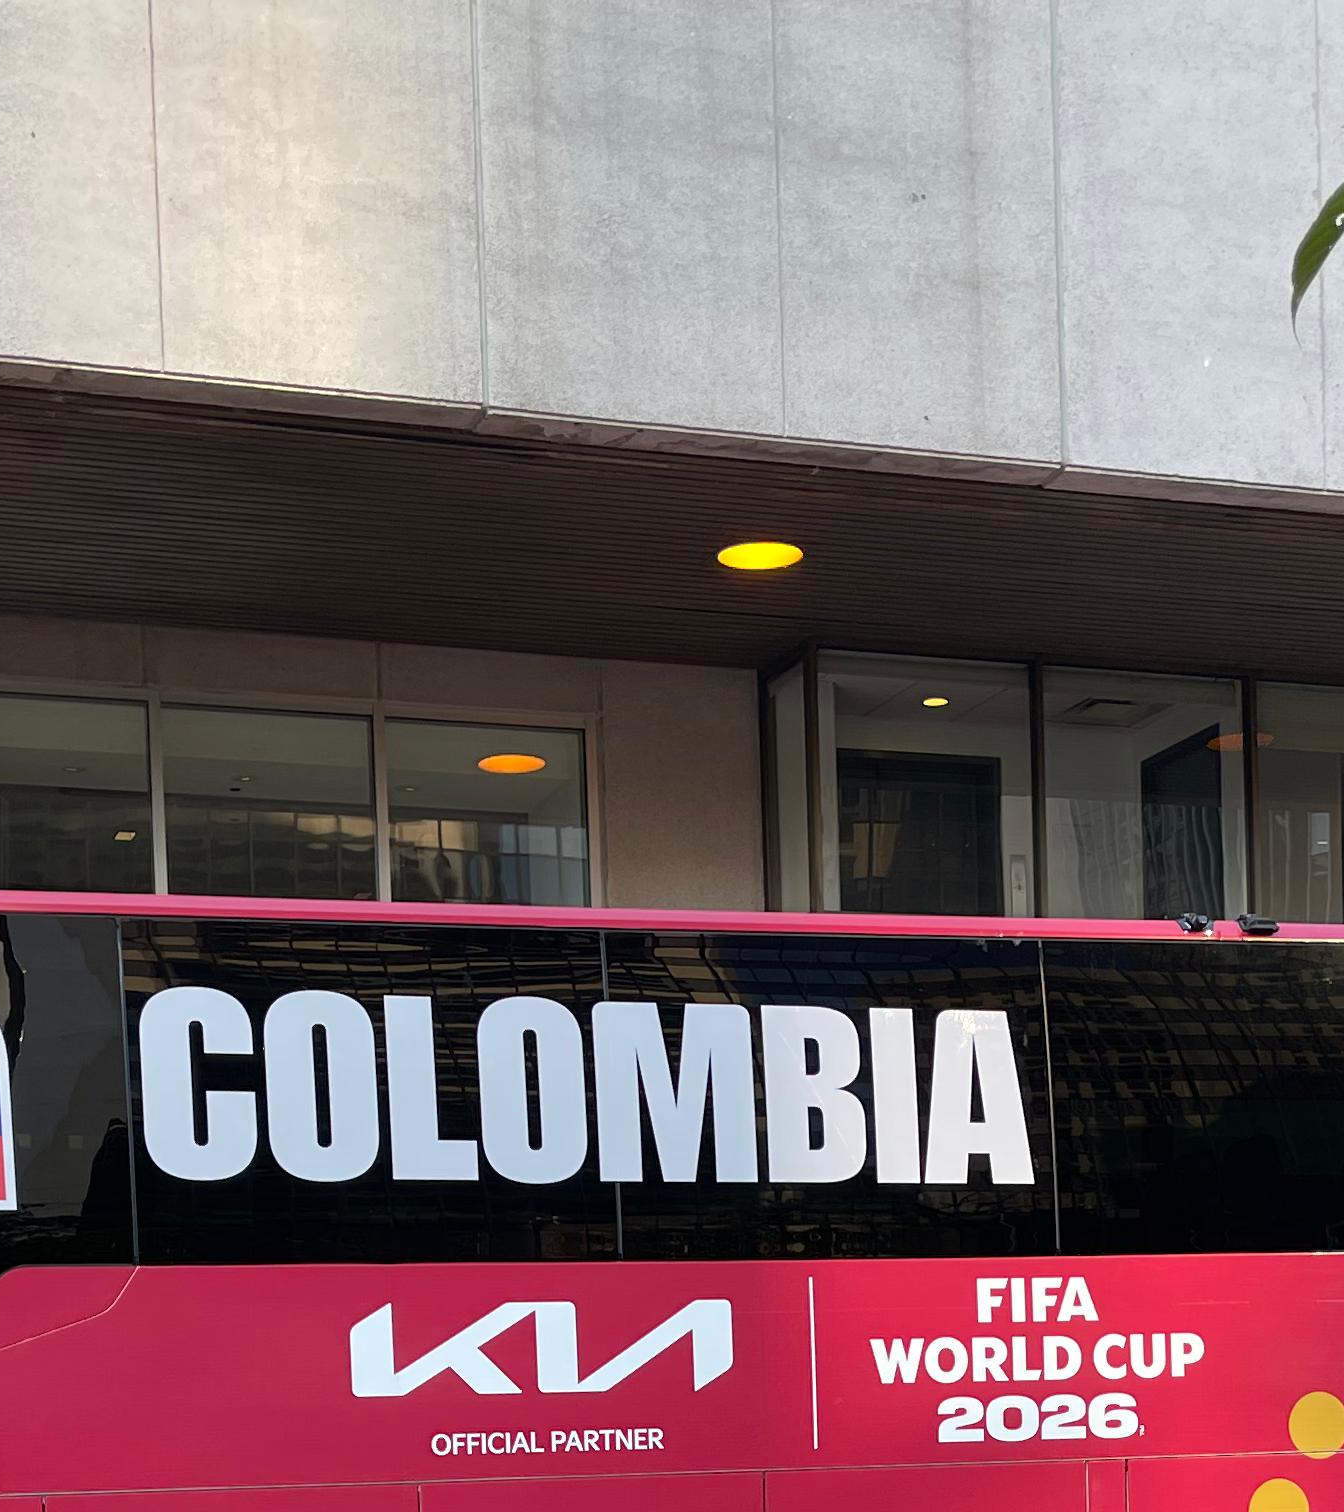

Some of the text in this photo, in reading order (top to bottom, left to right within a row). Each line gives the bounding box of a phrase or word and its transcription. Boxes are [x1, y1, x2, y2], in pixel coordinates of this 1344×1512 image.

[139, 985, 1036, 1185] COLOMBIA
[976, 1276, 1100, 1324] FIFA
[349, 1298, 735, 1398] KIA
[869, 1332, 1206, 1385] WORLD CUP
[431, 1428, 665, 1456] OFFICIAL PARTNER
[937, 1392, 1140, 1444] 2026
